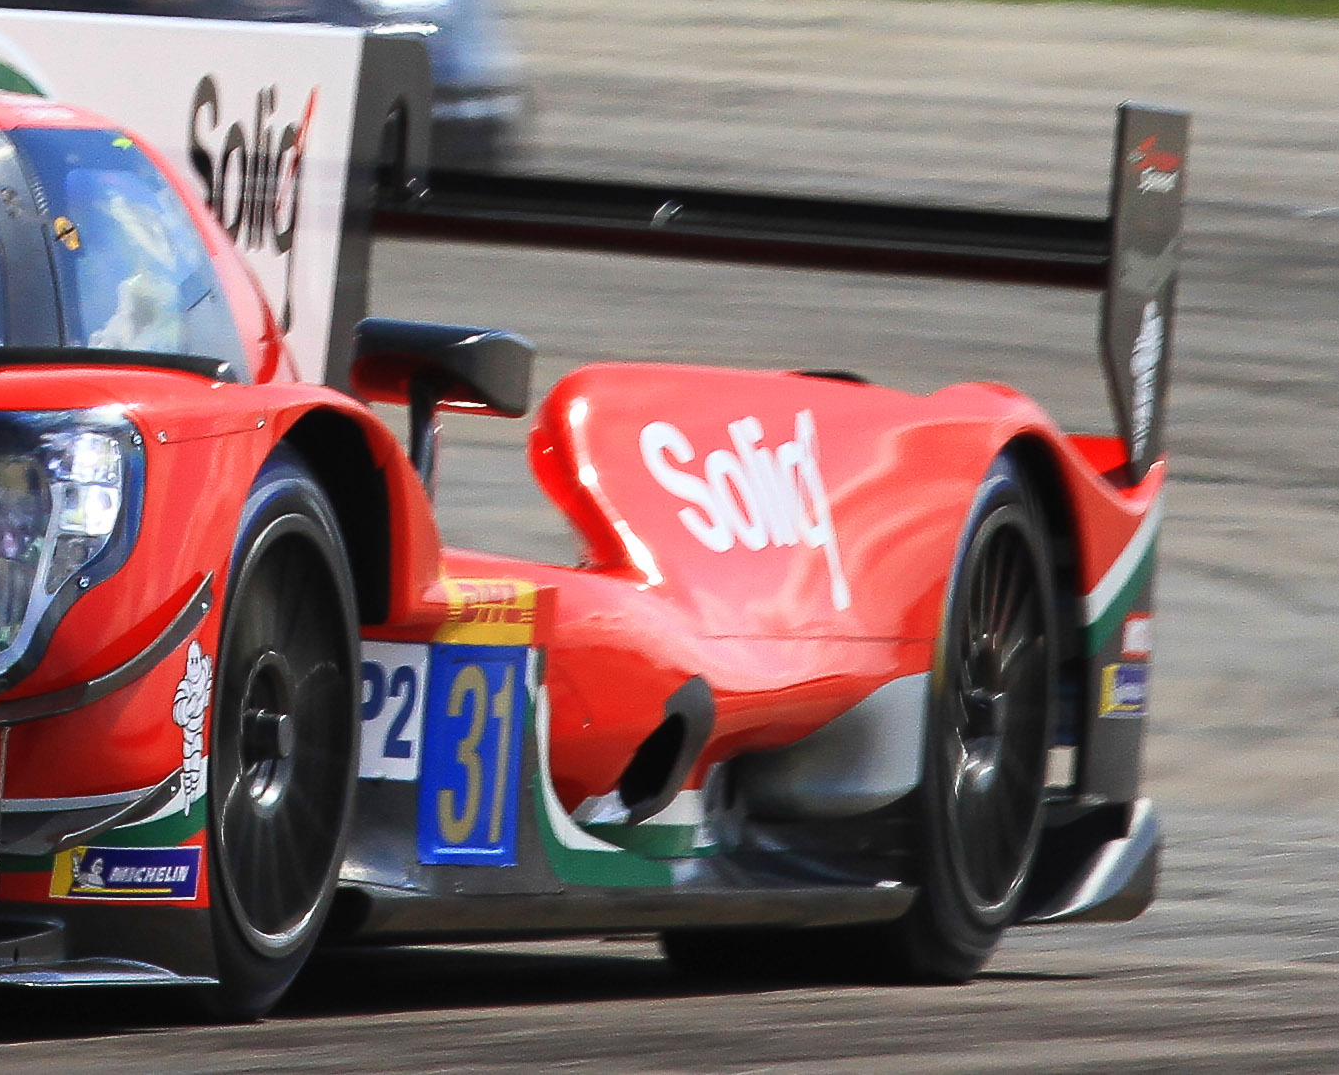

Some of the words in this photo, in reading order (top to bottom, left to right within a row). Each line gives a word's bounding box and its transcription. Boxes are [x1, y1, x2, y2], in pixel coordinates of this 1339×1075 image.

[639, 409, 851, 611] Soliq
[361, 661, 416, 758] P2
[439, 664, 516, 844] 31
[108, 865, 189, 883] MICHELIN
